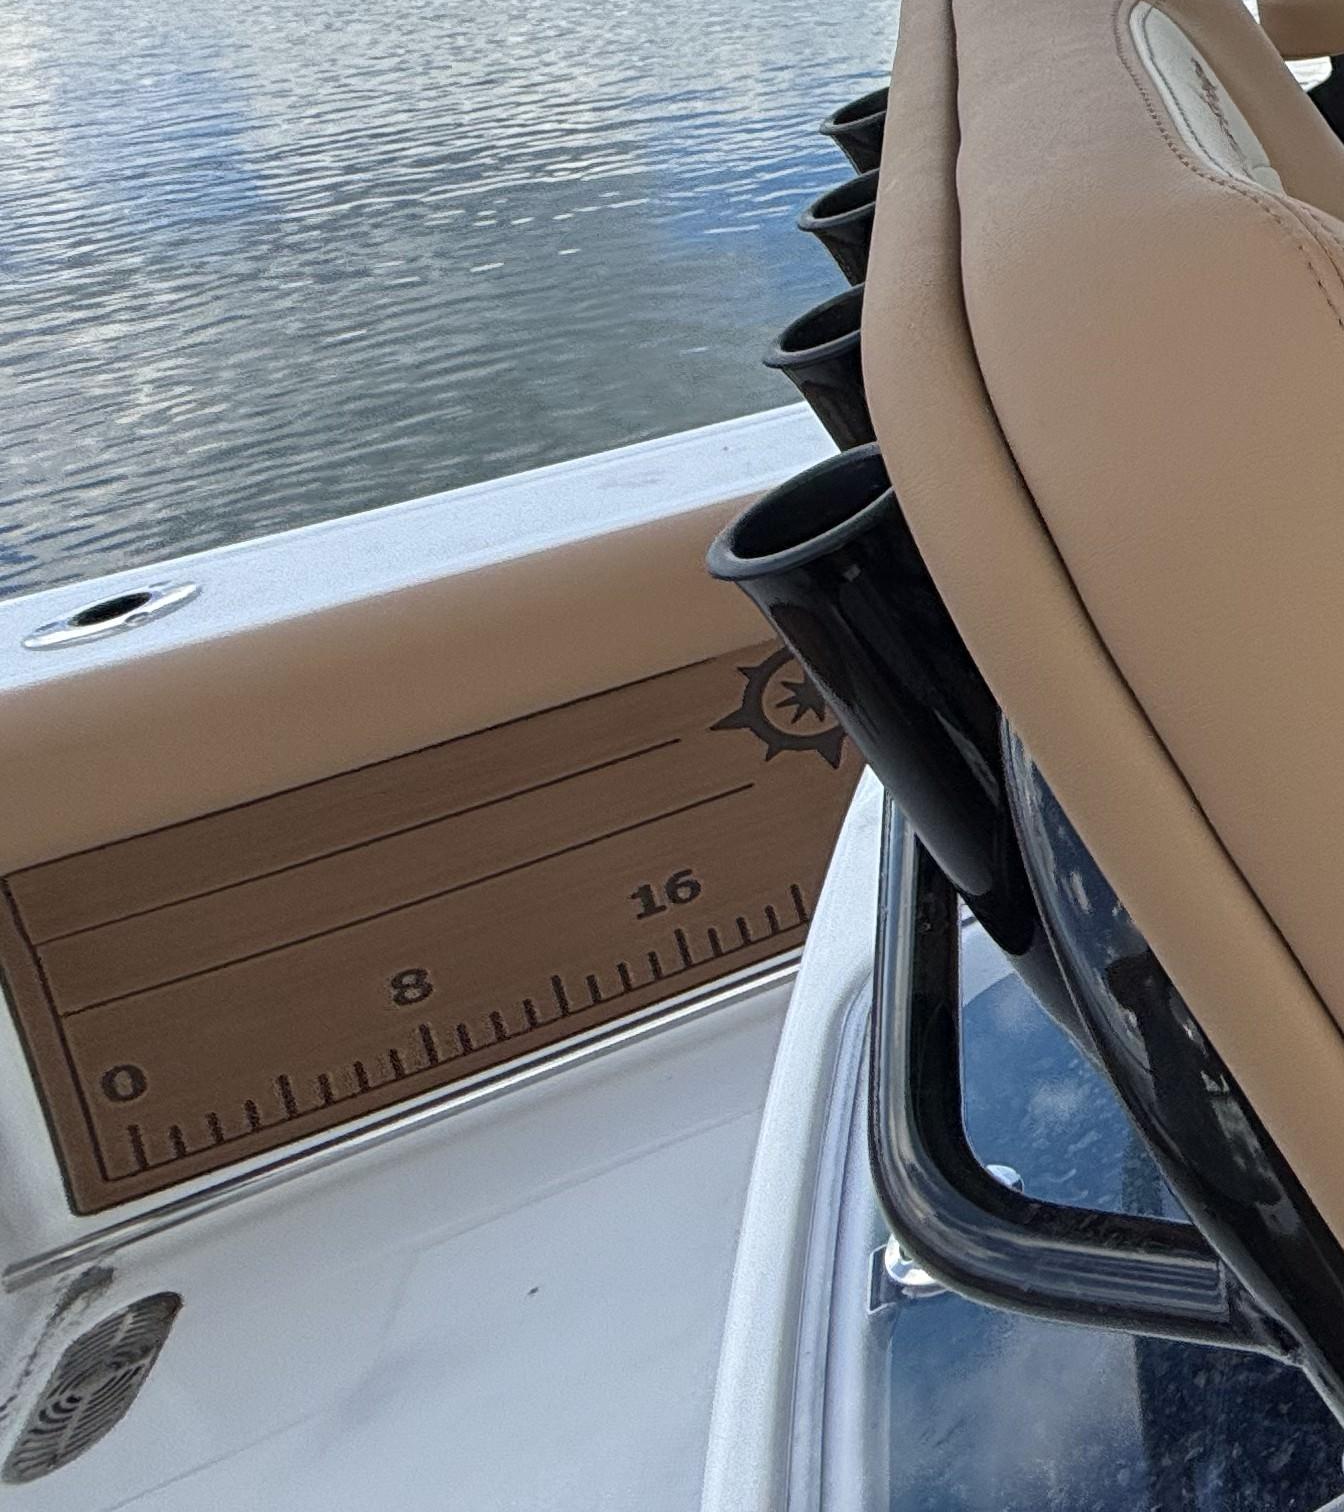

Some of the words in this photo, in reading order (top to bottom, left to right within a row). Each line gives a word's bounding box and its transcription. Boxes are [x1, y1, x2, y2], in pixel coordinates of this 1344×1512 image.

[629, 868, 703, 921] 16
[389, 968, 434, 1008] 8
[101, 1063, 149, 1104] 0
